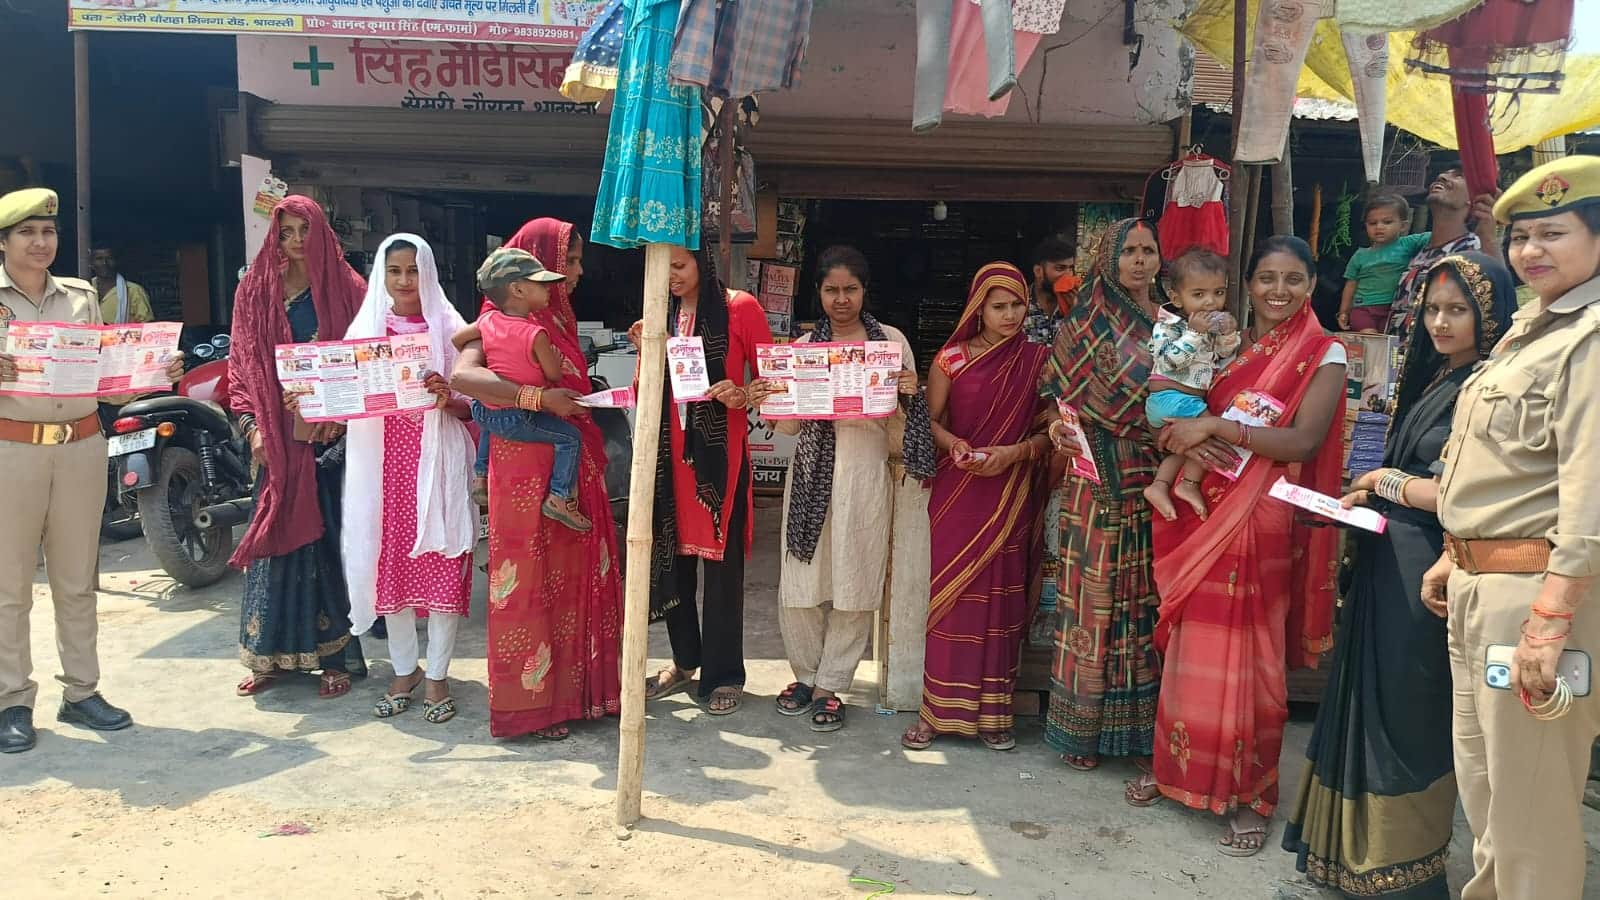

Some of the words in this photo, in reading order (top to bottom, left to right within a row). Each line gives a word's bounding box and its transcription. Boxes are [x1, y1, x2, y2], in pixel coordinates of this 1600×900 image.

[485, 0, 497, 12] पर
[81, 13, 102, 22] पता
[117, 12, 147, 23] सेमरी
[253, 16, 294, 28] श्रावस्ती
[332, 18, 366, 30] आनन्द
[367, 19, 397, 34] कुमार
[398, 18, 419, 32] सिंह
[348, 38, 434, 95] सिंह
